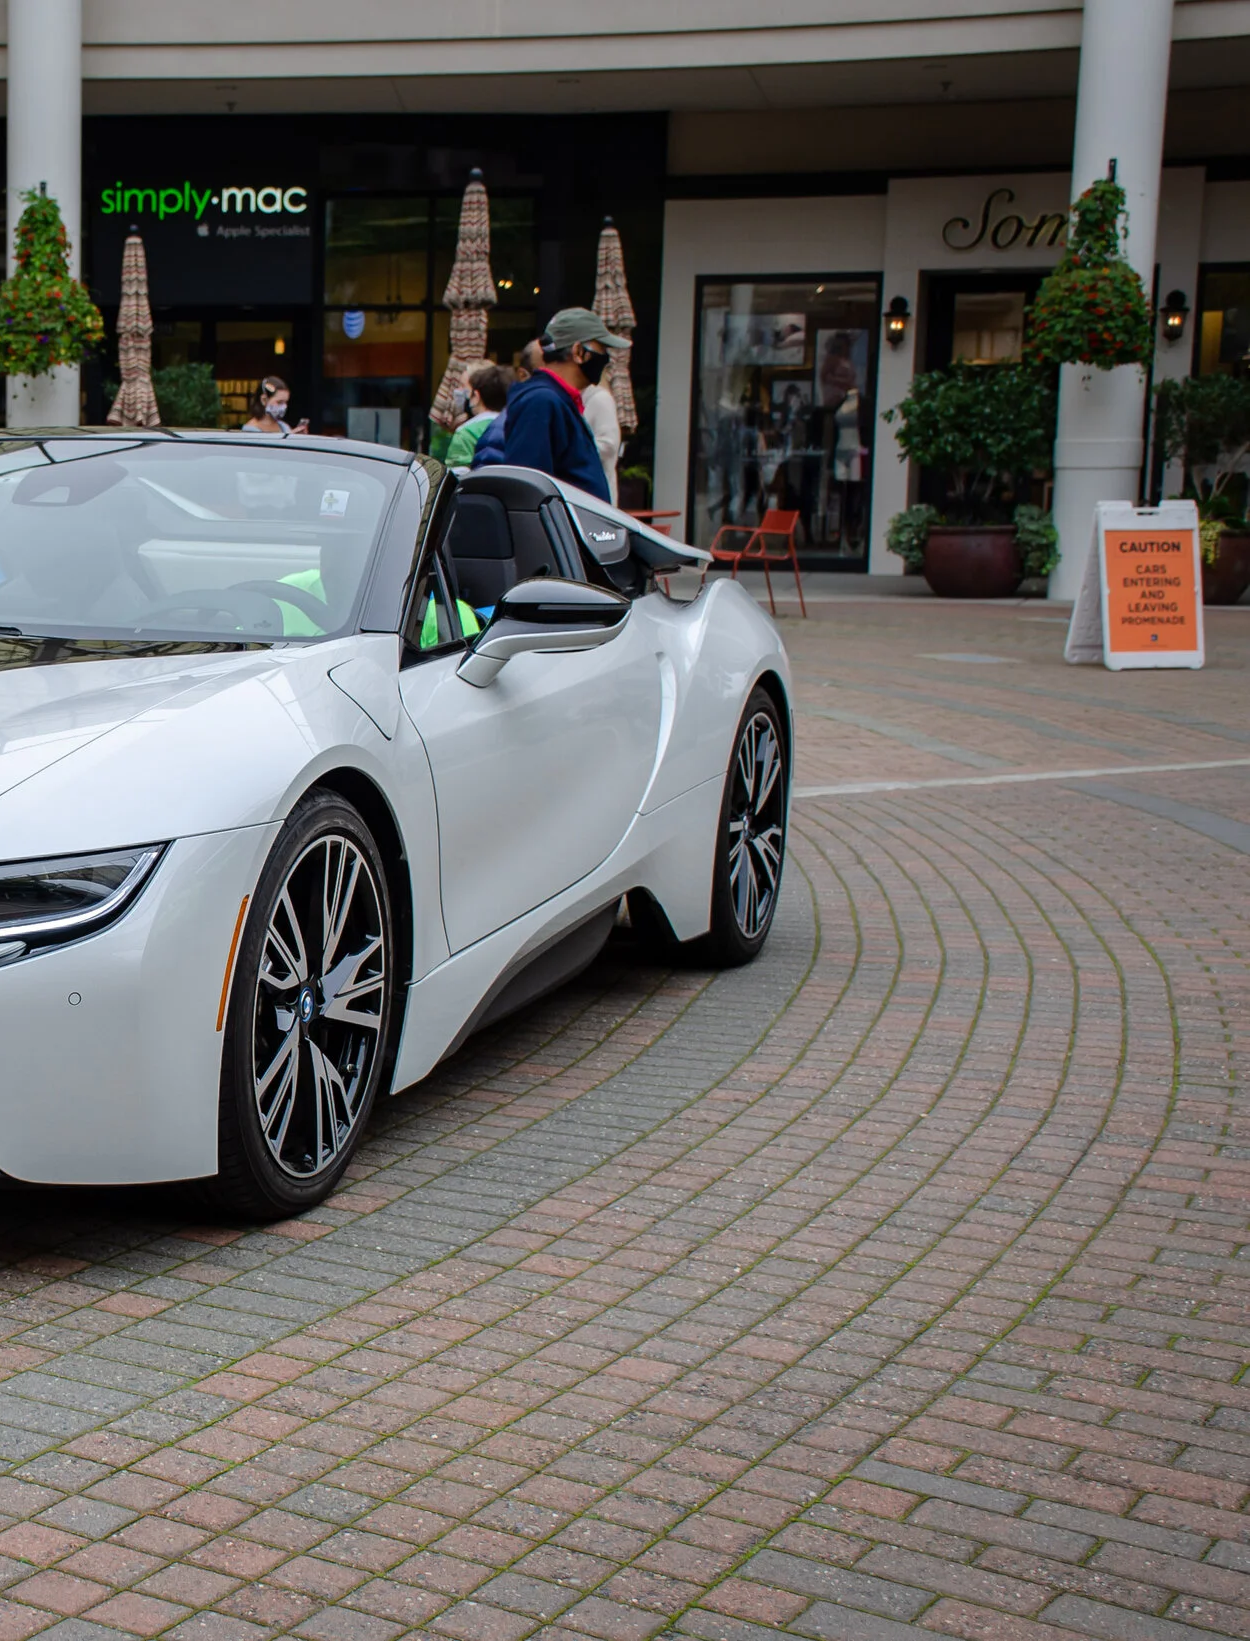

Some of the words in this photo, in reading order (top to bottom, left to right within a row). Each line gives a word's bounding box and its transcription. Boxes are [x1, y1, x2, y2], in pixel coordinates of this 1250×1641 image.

[216, 225, 251, 238] Apple
[255, 225, 310, 238] Specialist
[1119, 541, 1181, 553] CAUTION
[1136, 564, 1167, 575] CARS
[1123, 577, 1181, 588] ENTERING
[1140, 590, 1165, 600] AND
[1128, 602, 1178, 613] LEAVING
[1121, 615, 1186, 626] PROMENADE
